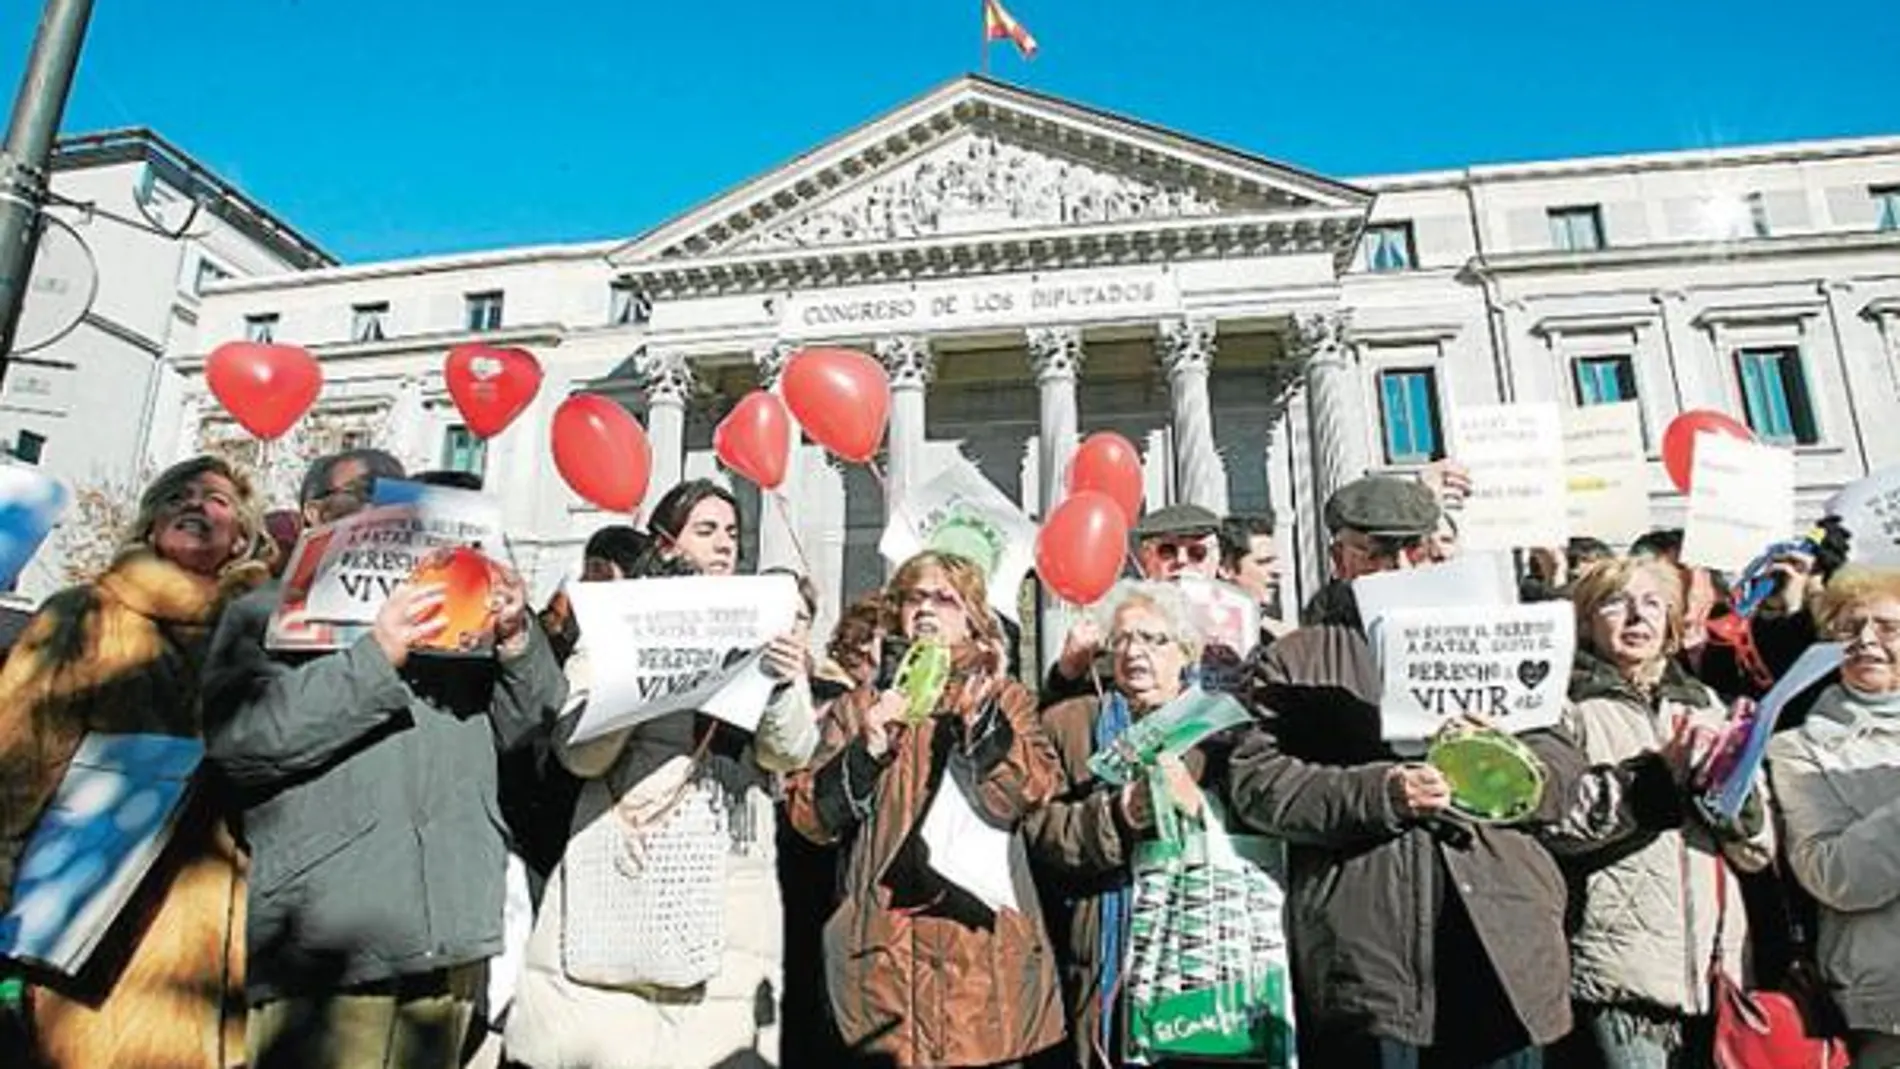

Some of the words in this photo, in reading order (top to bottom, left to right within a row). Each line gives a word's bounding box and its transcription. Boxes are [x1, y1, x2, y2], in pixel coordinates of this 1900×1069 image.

[803, 298, 916, 327] CONGRESO
[930, 296, 958, 317] DE
[972, 293, 1014, 313] LOS
[1031, 282, 1156, 309] DIPUTADOS
[1408, 660, 1501, 682] DERECHO
[1409, 685, 1510, 717] VIVIR
